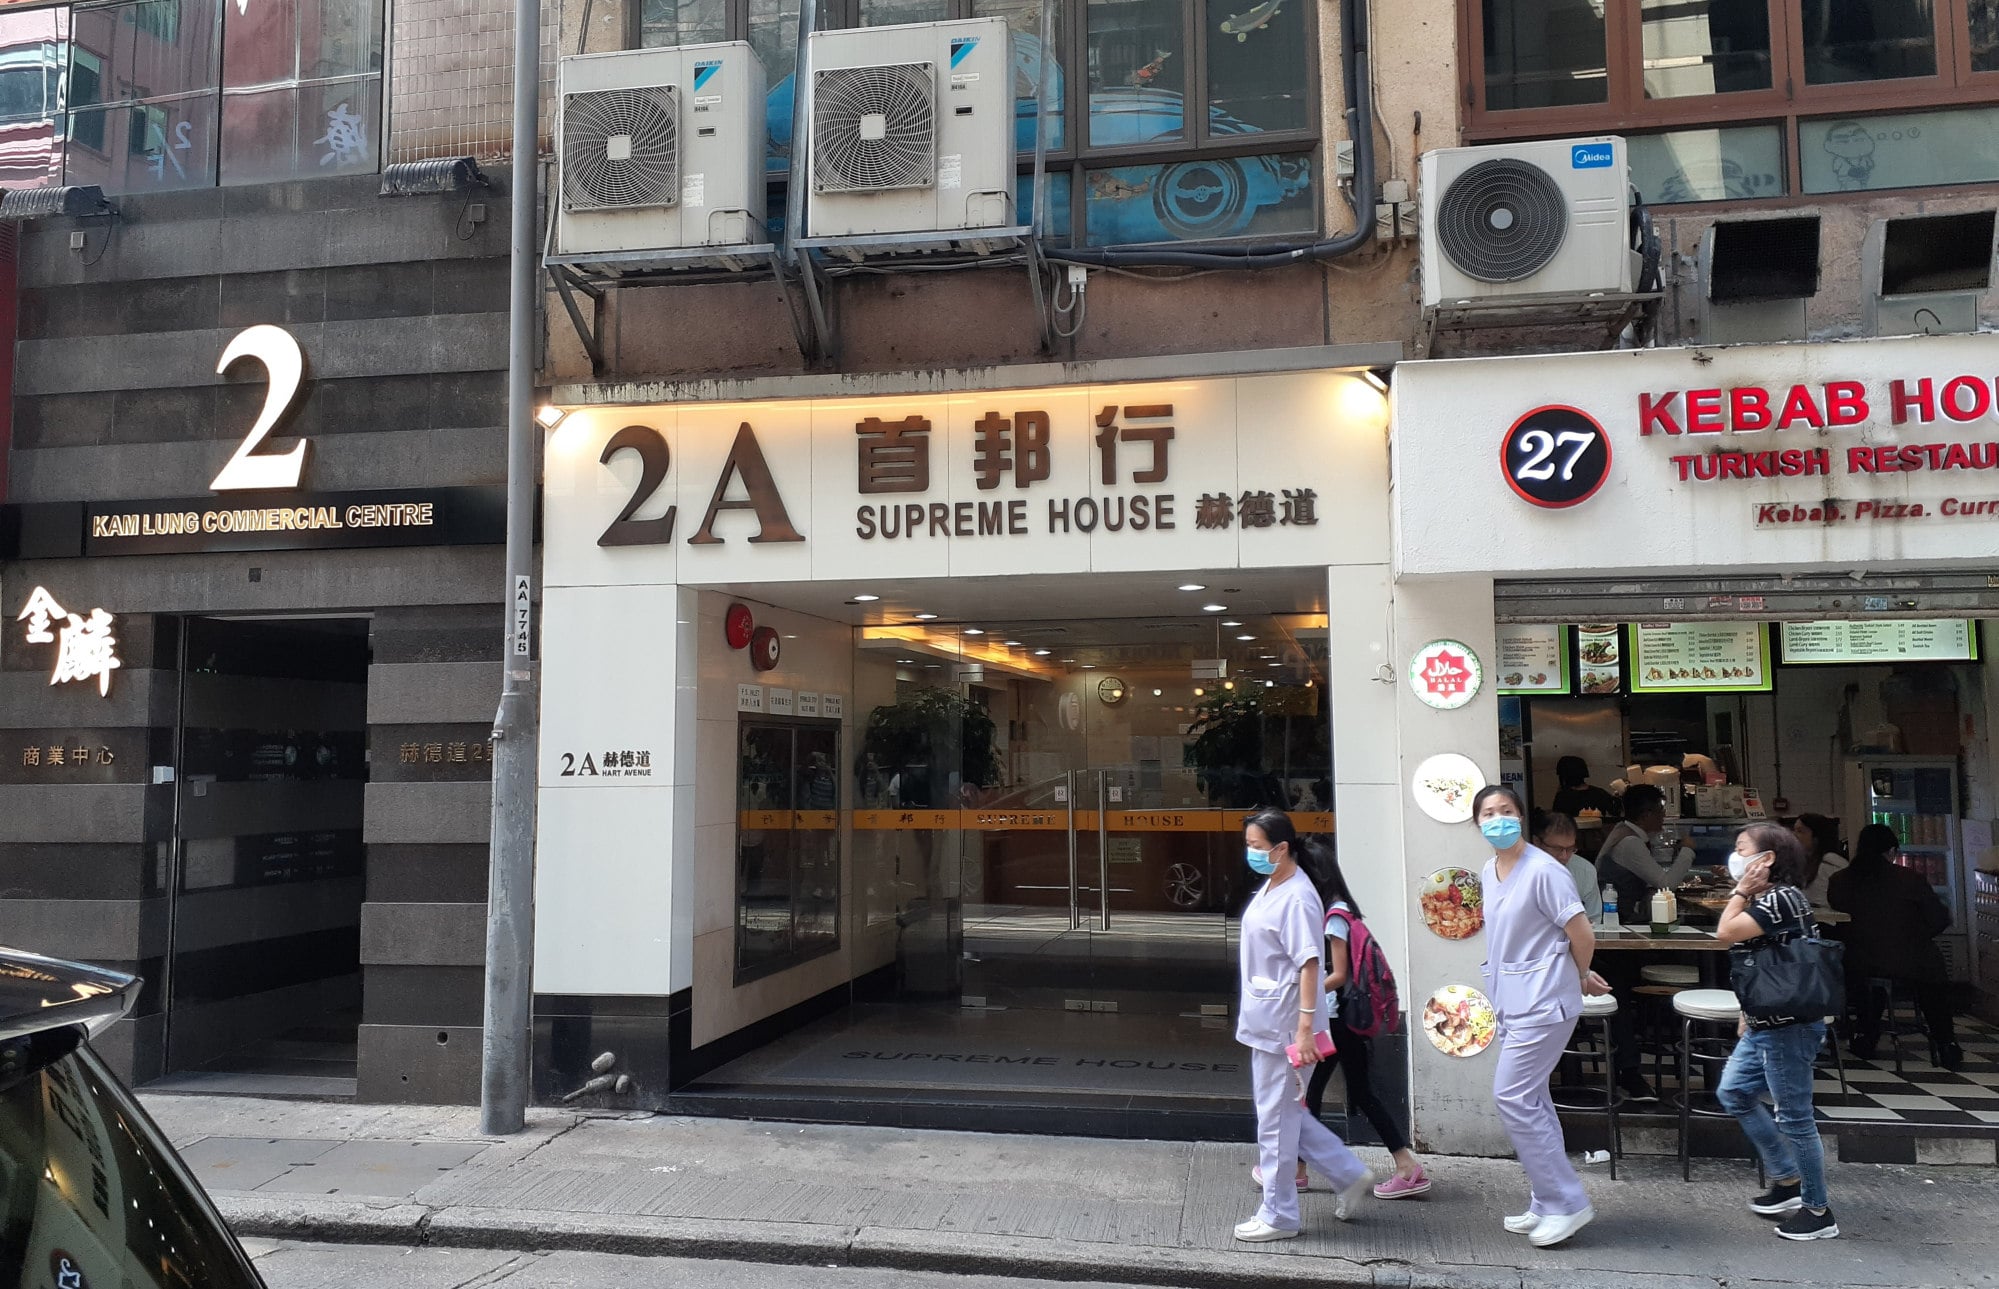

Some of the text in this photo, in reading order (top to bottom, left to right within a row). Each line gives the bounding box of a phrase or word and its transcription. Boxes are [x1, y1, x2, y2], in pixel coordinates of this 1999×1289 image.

[1580, 151, 1611, 162] Midea
[211, 324, 308, 490] 2
[1638, 374, 1999, 437] KEBAB HO
[855, 403, 1176, 495] 首邦行
[1516, 429, 1595, 482] 27
[1671, 442, 1999, 482] TURKISH RESTAU
[597, 422, 806, 547] 2A
[93, 503, 434, 537] KAM LUNG COMMERCIAL CENTRE
[856, 487, 1318, 540] SUPREME HOUSE 赫德道
[1758, 497, 1999, 524] Kebab. Pizza. Curr
[517, 579, 528, 653] AA 7745
[1428, 659, 1463, 677] حلال
[23, 745, 115, 767] 商業中心
[561, 750, 651, 777] 2A 赫德道
[602, 768, 652, 777] HART AVENUE
[842, 1050, 1240, 1073] SUPREME HOUSE
